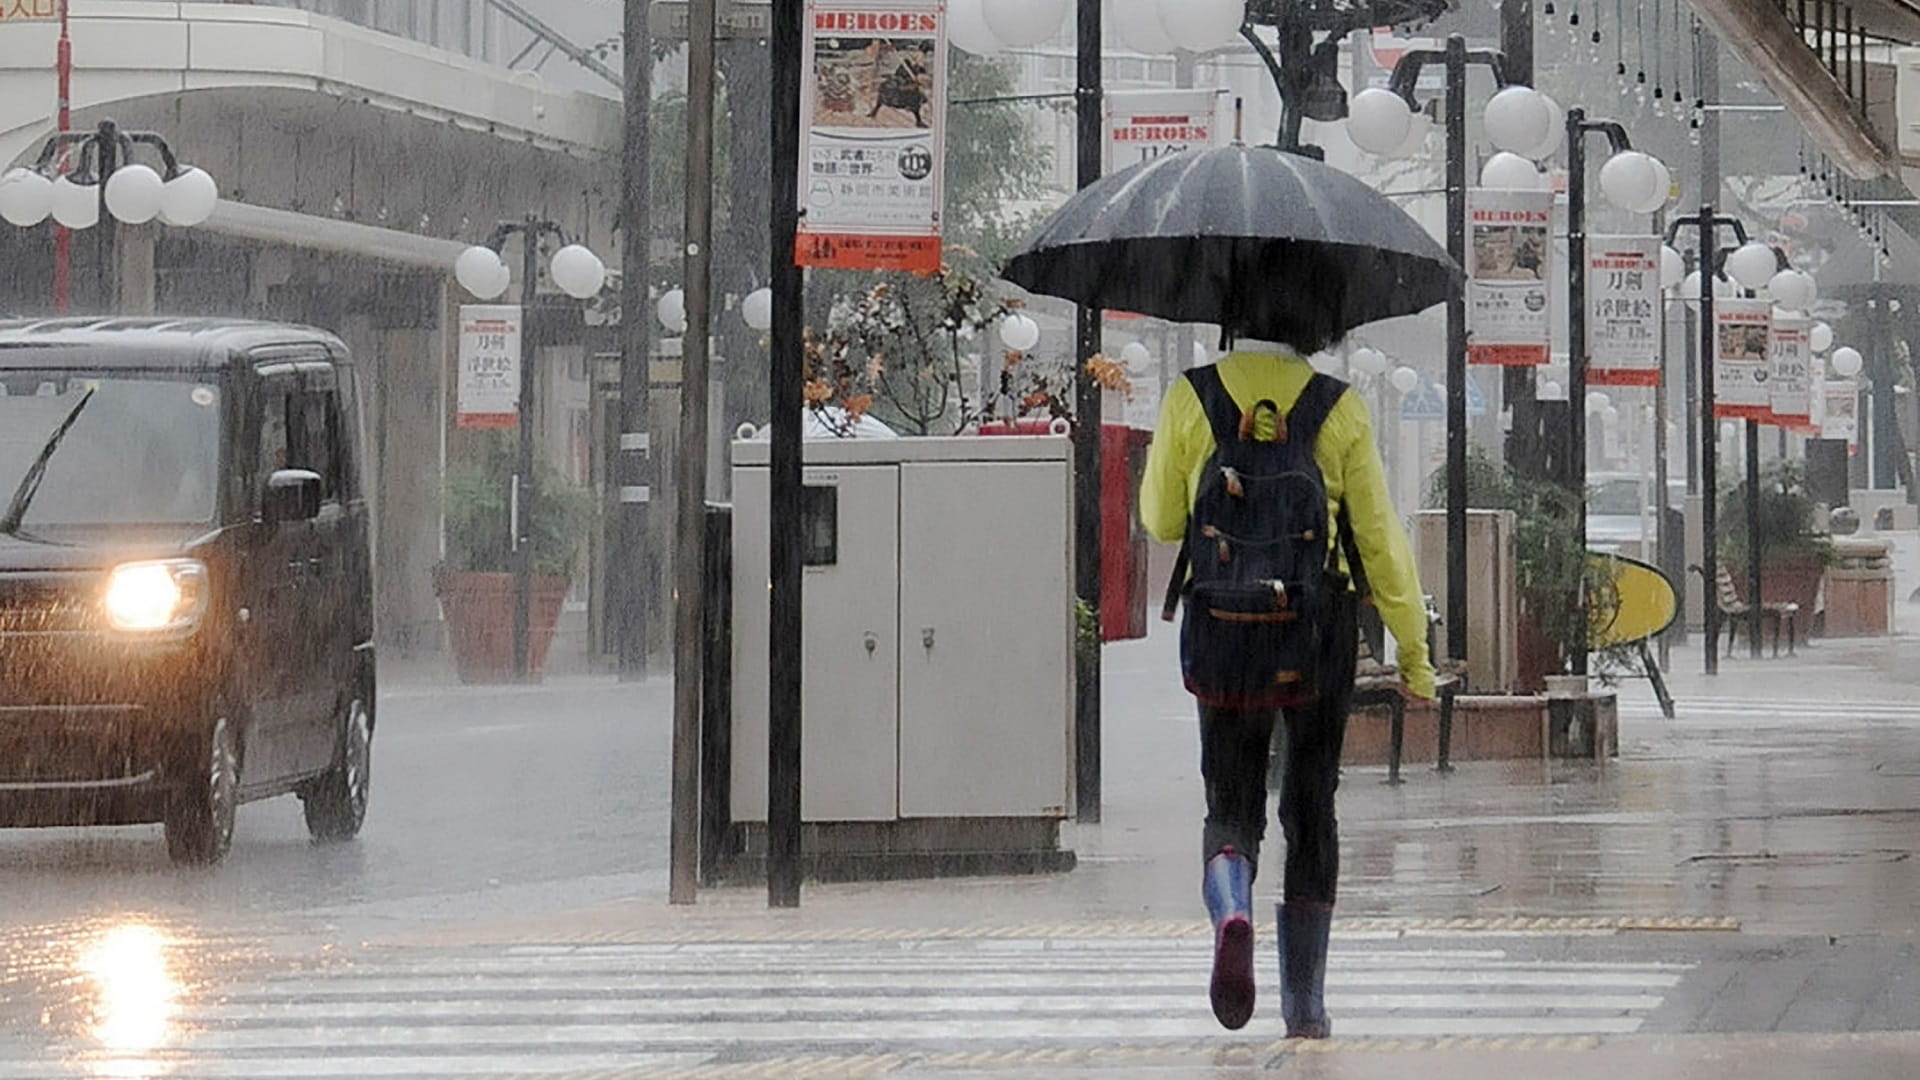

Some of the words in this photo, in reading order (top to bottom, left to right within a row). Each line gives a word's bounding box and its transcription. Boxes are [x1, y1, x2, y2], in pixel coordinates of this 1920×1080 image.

[815, 13, 936, 31] HEROES
[1113, 126, 1208, 141] HEROES
[1473, 210, 1547, 222] HEROES
[1595, 299, 1652, 318] 浮世絵
